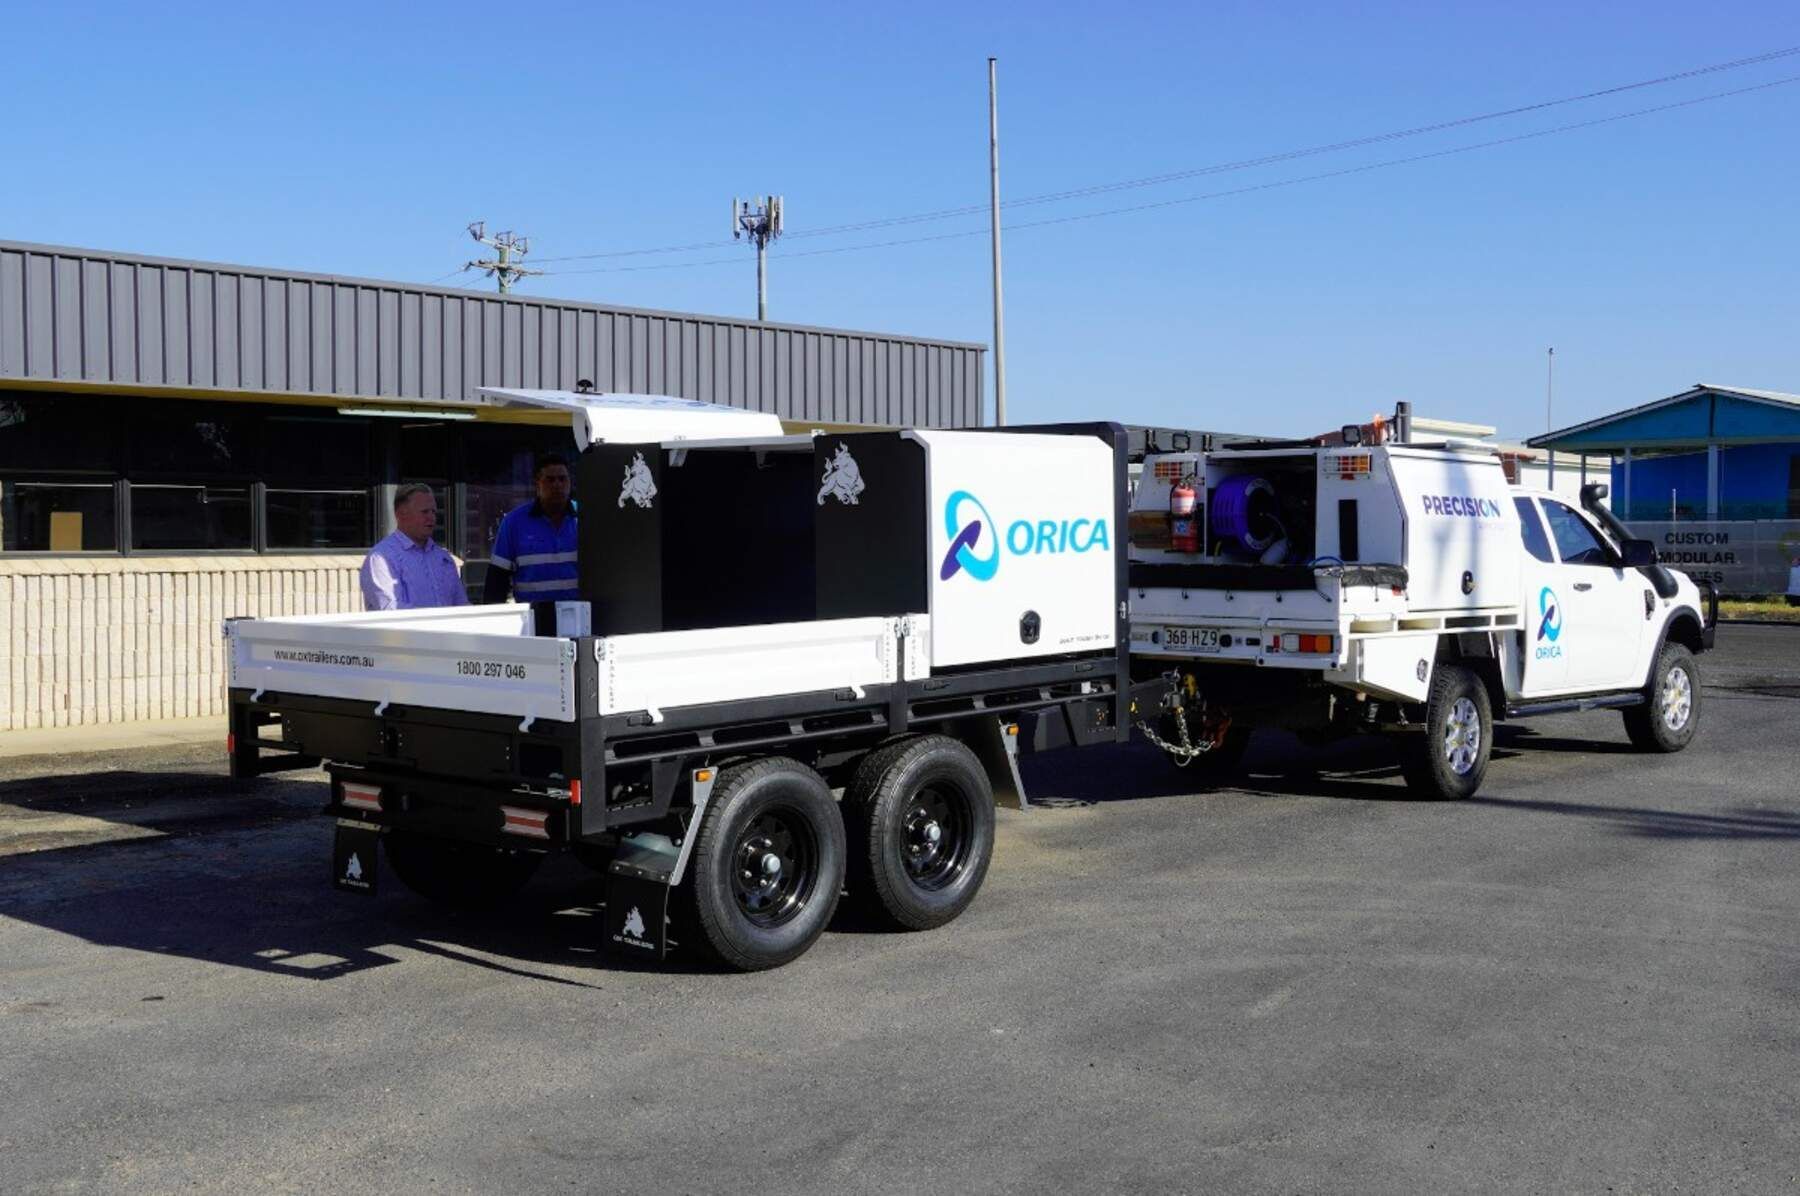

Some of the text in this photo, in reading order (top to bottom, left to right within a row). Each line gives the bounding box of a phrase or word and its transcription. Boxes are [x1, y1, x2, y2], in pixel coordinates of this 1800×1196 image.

[1422, 494, 1501, 518] PRECISION
[1006, 518, 1110, 556] ORICA
[1664, 532, 1729, 545] CUSTOM
[1660, 551, 1735, 564] MODULAR
[273, 649, 375, 668] www.oxtrailers.com.au
[1535, 644, 1562, 660] ORICA
[456, 660, 526, 680] 1800 297 046
